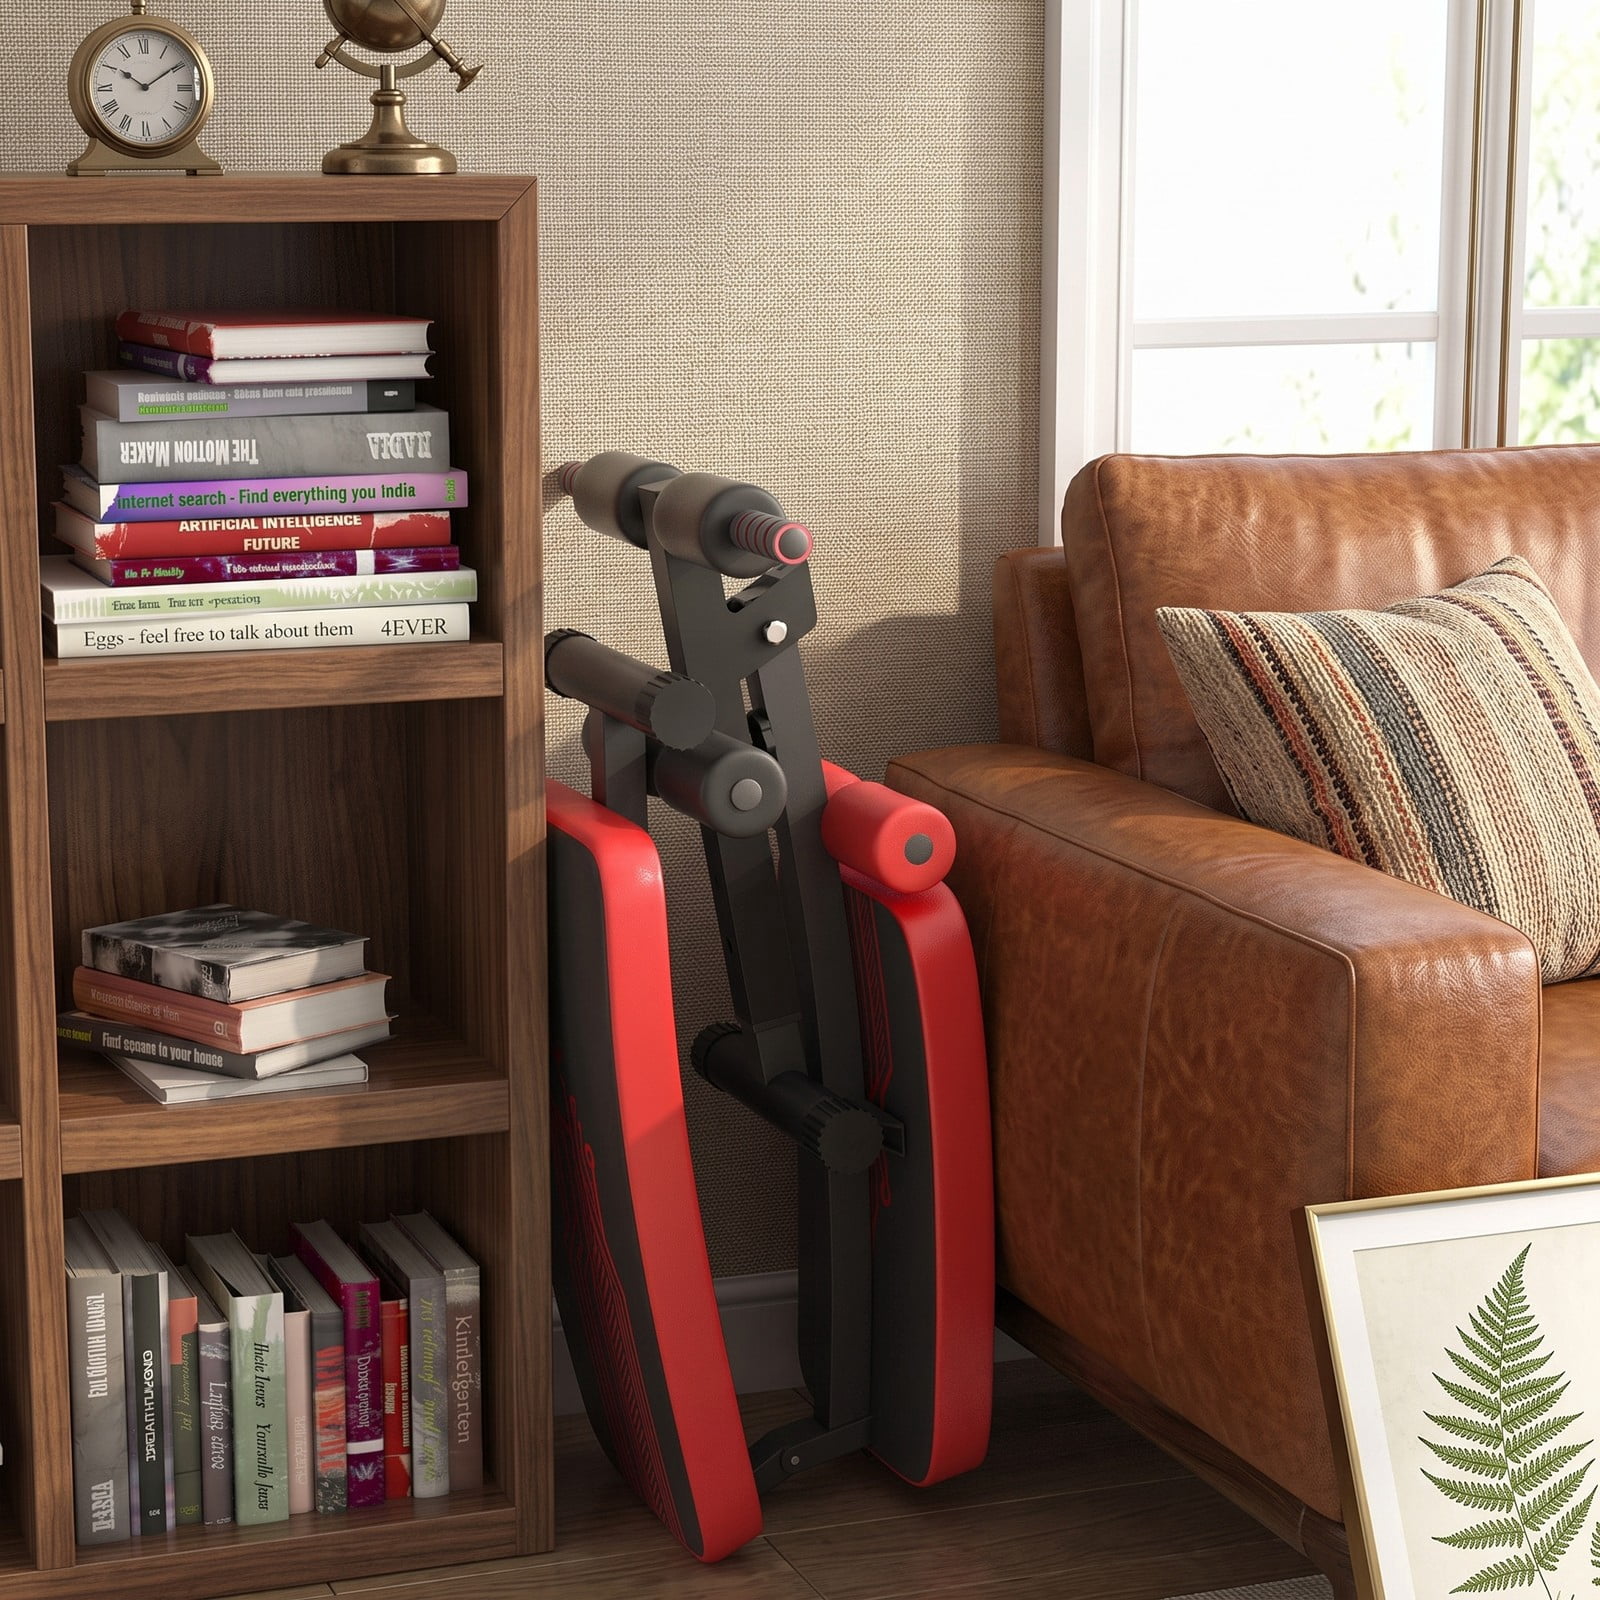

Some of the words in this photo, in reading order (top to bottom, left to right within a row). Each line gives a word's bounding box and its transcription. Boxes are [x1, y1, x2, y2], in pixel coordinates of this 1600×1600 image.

[120, 440, 170, 467] MAKER
[173, 439, 230, 465] MOTION
[232, 439, 260, 465] THE
[178, 490, 226, 507] search
[239, 488, 268, 504] Find
[272, 485, 348, 505] everything
[351, 487, 376, 504] you
[179, 518, 259, 532] ARTIFICIAL
[262, 515, 362, 530] INTELLIGENCE
[243, 536, 301, 551] FUTURE
[84, 631, 124, 650] Eggs
[140, 628, 169, 644] feel
[174, 627, 205, 643] free
[209, 628, 225, 641] to
[230, 624, 259, 640] talk
[265, 623, 309, 639] about
[314, 622, 354, 637] them
[381, 618, 448, 637] 4EVER
[169, 1045, 192, 1063] your
